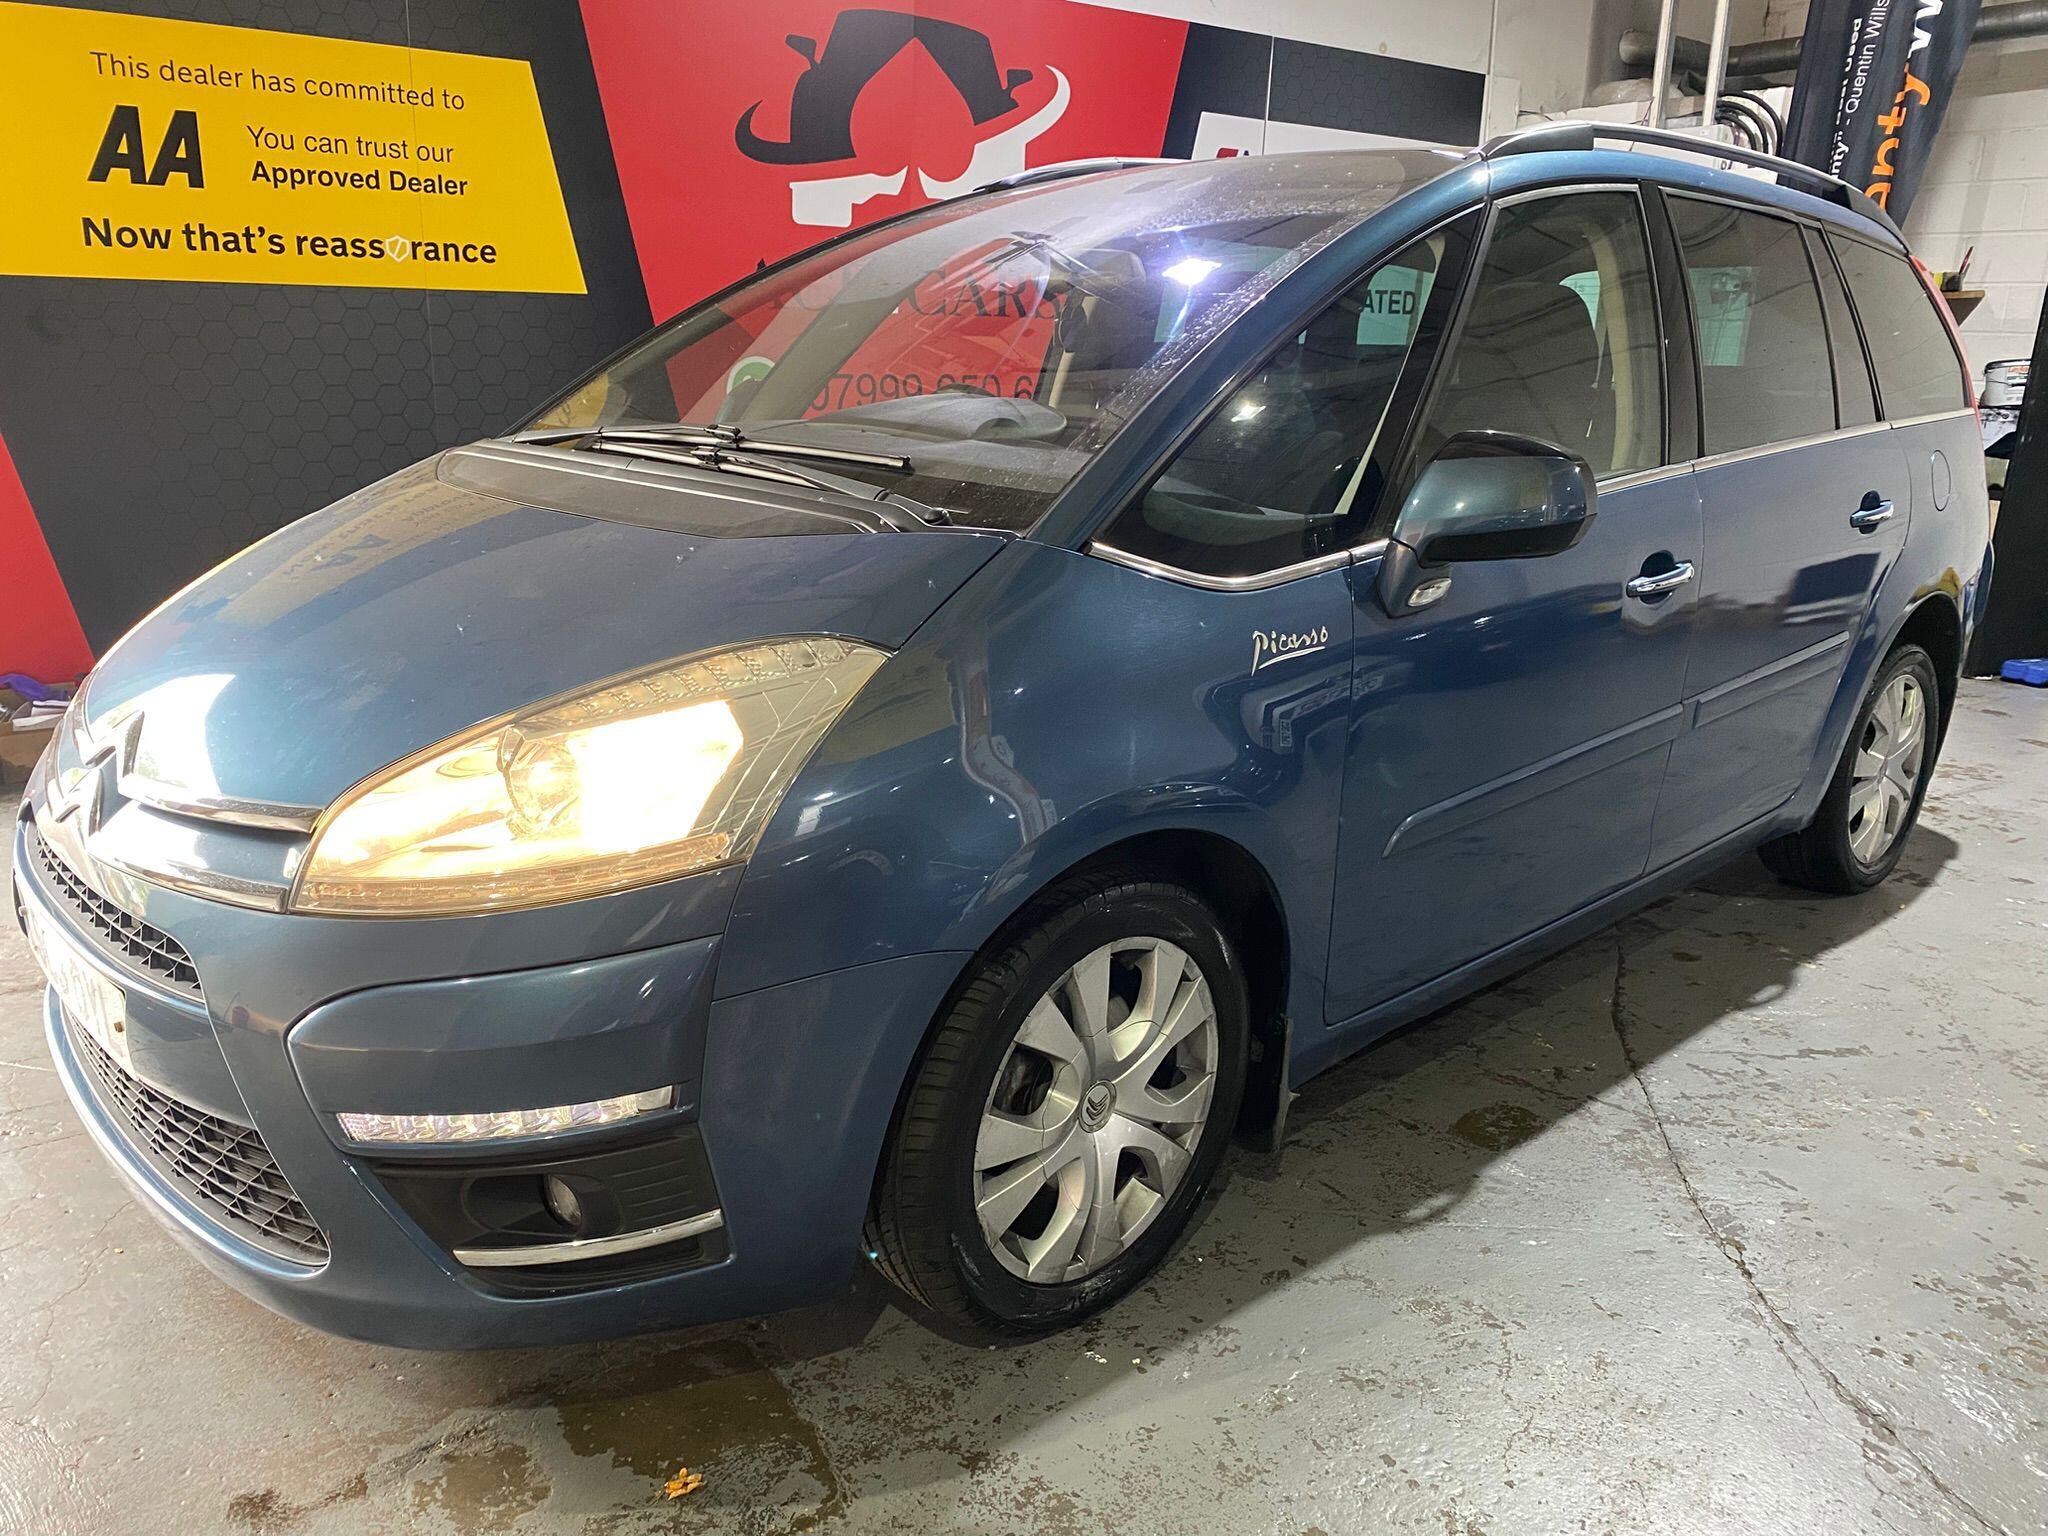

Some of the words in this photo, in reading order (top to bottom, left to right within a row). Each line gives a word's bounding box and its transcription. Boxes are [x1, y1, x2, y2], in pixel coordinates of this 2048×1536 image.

[89, 51, 150, 79] This
[159, 59, 243, 88] dealer
[251, 69, 296, 93] has
[304, 79, 434, 107] committed
[442, 89, 464, 110] to
[1845, 44, 1876, 113] Quentin
[87, 105, 205, 189] AA
[246, 125, 295, 151] You
[304, 135, 348, 155] can
[356, 136, 409, 159] trust
[416, 145, 453, 163] our
[252, 160, 380, 190] Approved
[389, 170, 468, 195] Dealer
[82, 216, 171, 250] Now
[182, 222, 286, 255] that’s
[1251, 625, 1329, 677] Picasso
